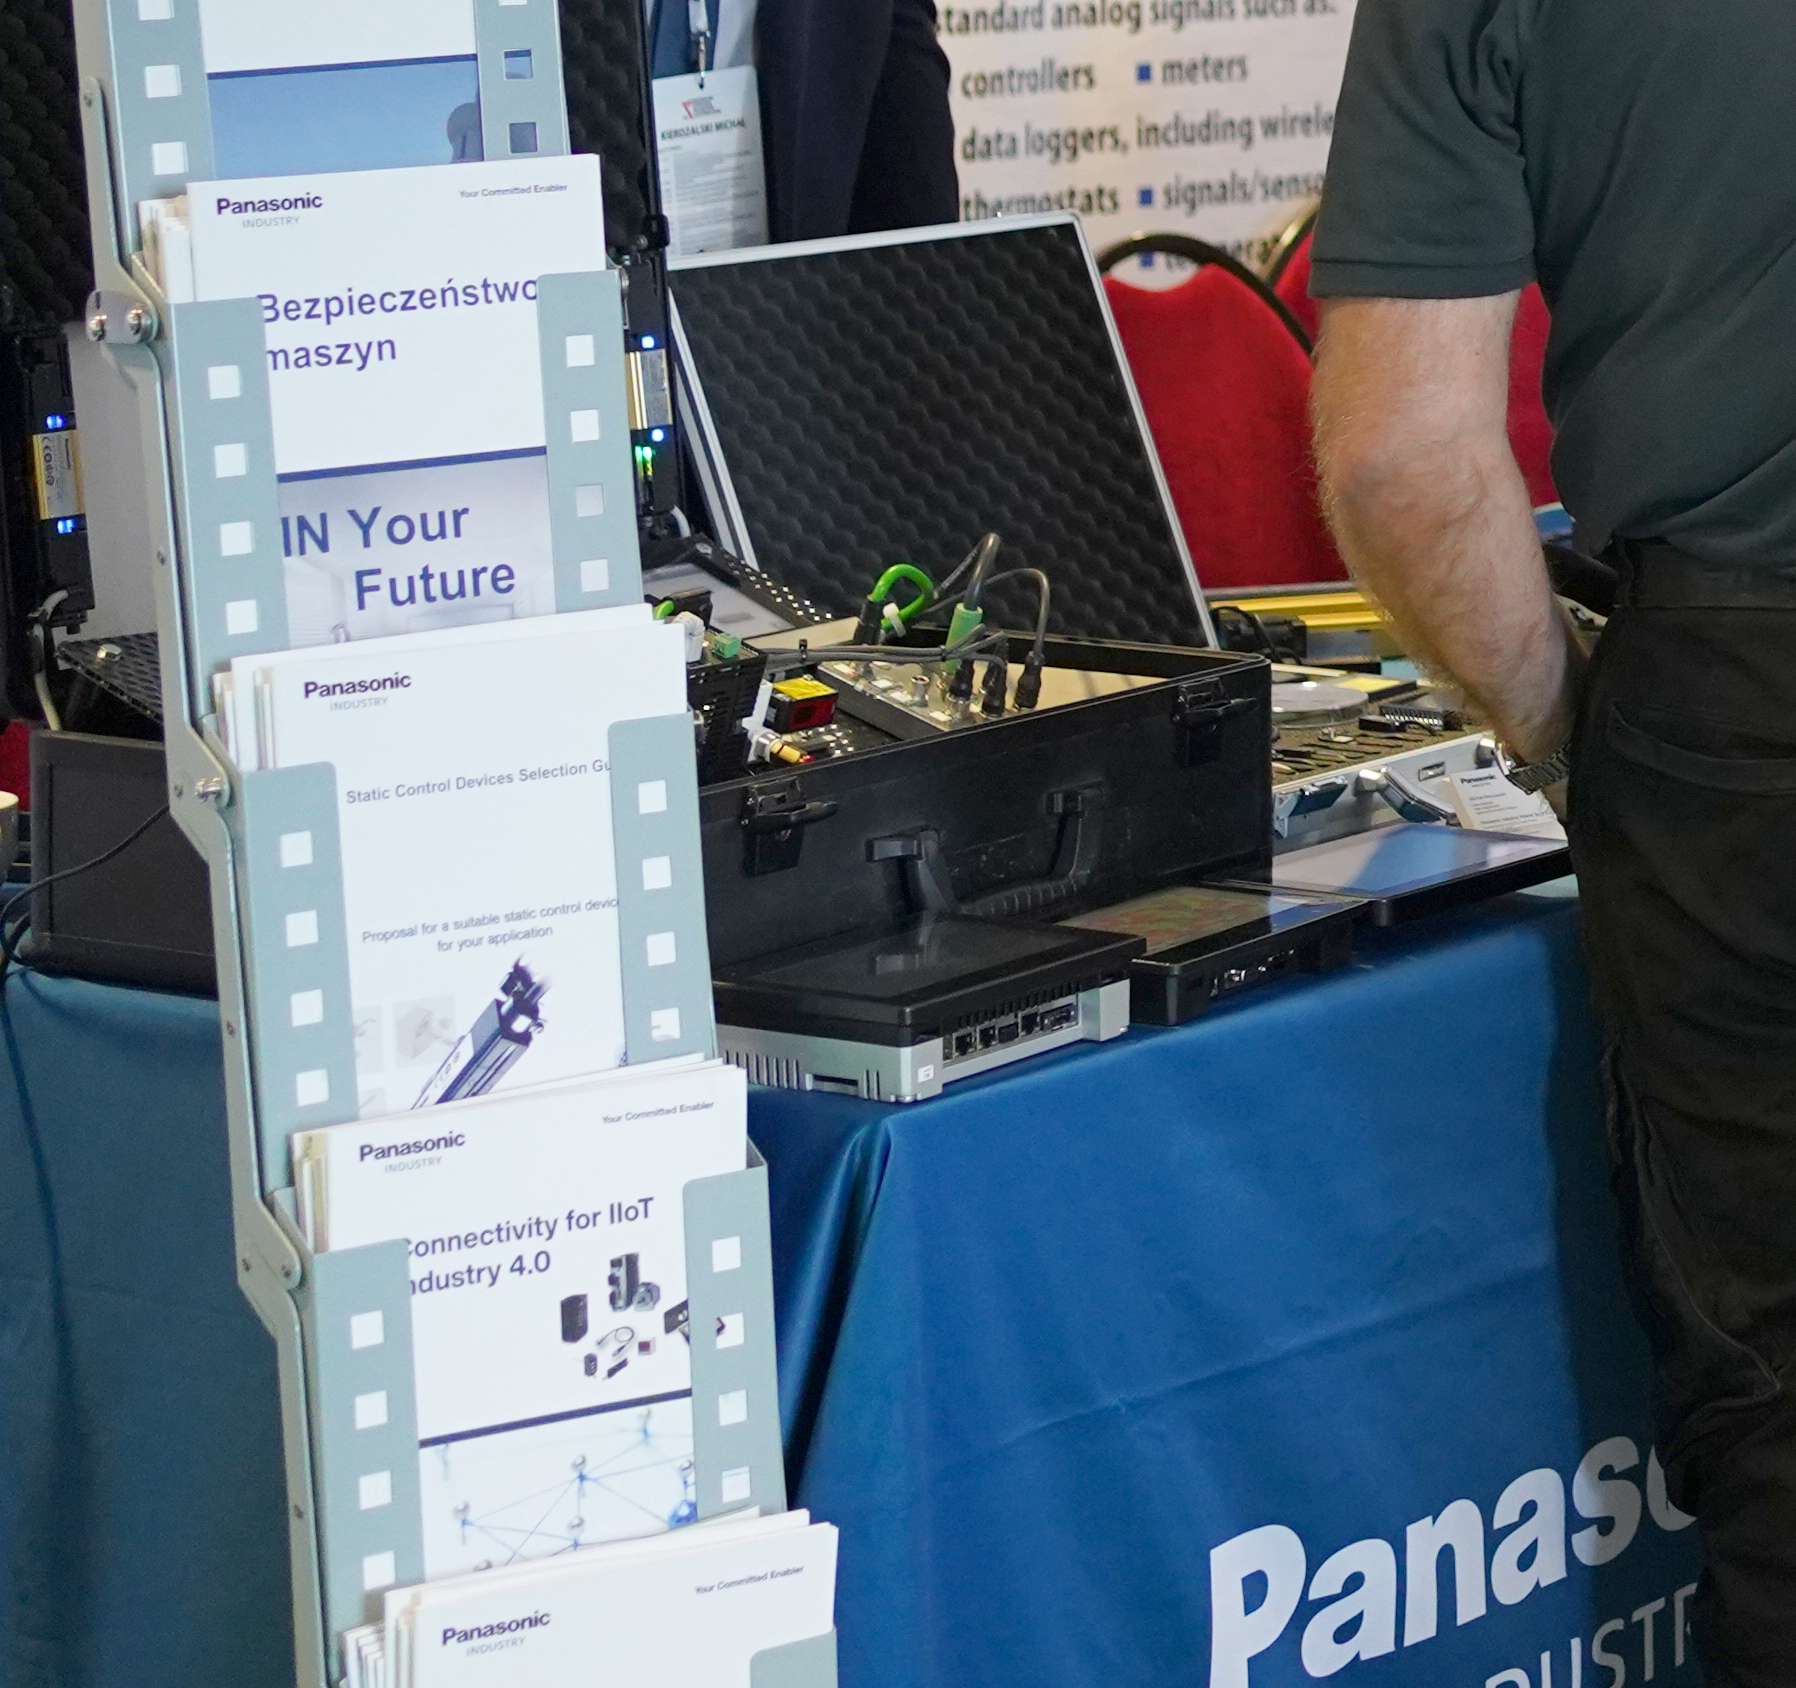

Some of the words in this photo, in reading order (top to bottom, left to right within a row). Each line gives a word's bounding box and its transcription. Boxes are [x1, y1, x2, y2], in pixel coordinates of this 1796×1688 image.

[961, 57, 1095, 99] controllers
[1161, 53, 1249, 87] meters
[962, 124, 1018, 162] data
[1024, 122, 1129, 166] loggers,
[1136, 110, 1254, 151] including
[1260, 103, 1334, 141] wirele
[216, 193, 324, 215] Panasonic
[459, 188, 479, 200] Your
[481, 185, 532, 197] Committed
[533, 182, 568, 194] Enabler
[1162, 165, 1324, 217] signals/senso
[241, 216, 301, 228] INDUSTRY
[258, 276, 537, 325] Bezpieczeństwo
[264, 336, 397, 374] maszyn
[280, 512, 330, 558] IN
[348, 505, 470, 549] Your
[355, 562, 515, 611] Future
[304, 672, 412, 699] Panasonic
[329, 697, 389, 711] INDUSTRY
[346, 784, 391, 805] Static
[395, 778, 451, 799] Control
[455, 772, 514, 793] Devices
[518, 764, 588, 785] Selection
[592, 759, 612, 774] Gu
[362, 924, 418, 946] Proposal
[421, 921, 438, 935] for
[442, 922, 449, 932] a
[453, 912, 500, 931] suitable
[504, 907, 536, 924] static
[539, 901, 582, 921] control
[585, 896, 619, 913] devic
[437, 940, 454, 952] for
[457, 939, 485, 953] your
[487, 925, 553, 949] application
[602, 1114, 623, 1125] Your
[625, 1107, 677, 1121] Committed
[679, 1100, 714, 1114] Enabler
[359, 1130, 466, 1162] Panasonic
[384, 1156, 443, 1174] INDUSTRY
[566, 1210, 601, 1233] for
[410, 1262, 501, 1296] ndustry
[509, 1250, 552, 1276] 4.0
[695, 1584, 715, 1596] Your
[716, 1574, 768, 1590] Committed
[769, 1565, 805, 1582] Enabler
[442, 1609, 551, 1646] Panasonic
[466, 1636, 526, 1656] INDUSTRY
